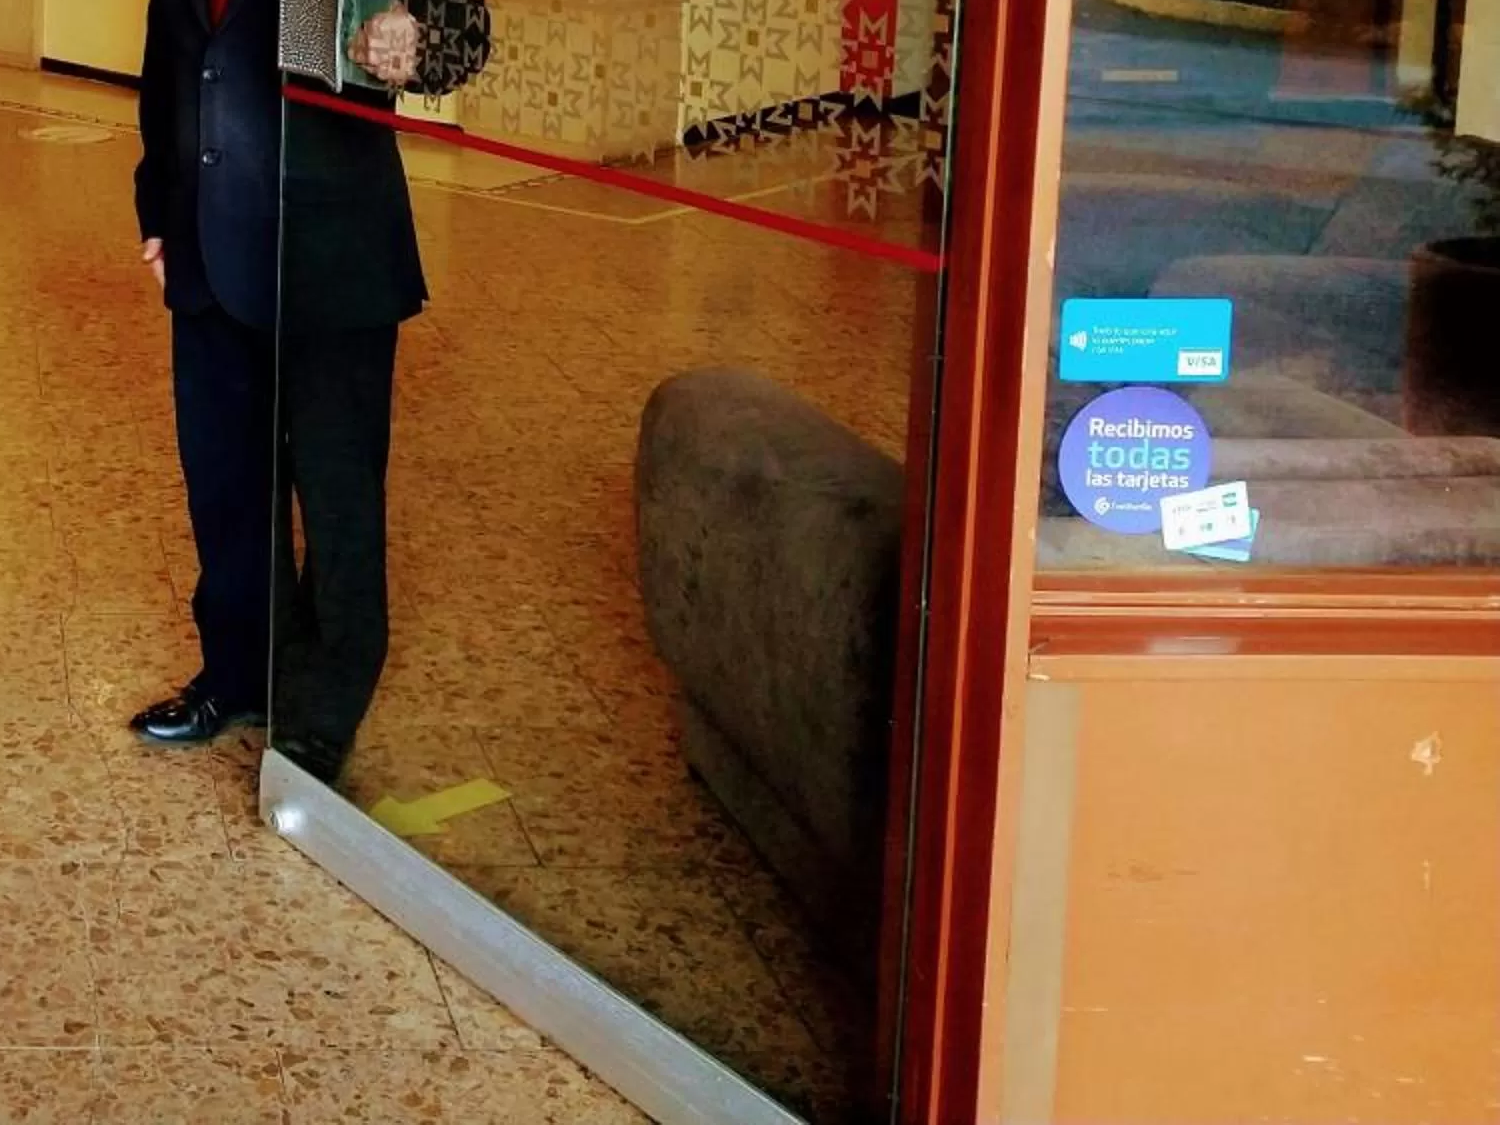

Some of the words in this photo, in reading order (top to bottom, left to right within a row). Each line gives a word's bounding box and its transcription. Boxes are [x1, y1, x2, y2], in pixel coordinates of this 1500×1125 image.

[1187, 356, 1217, 367] VISA
[1089, 418, 1194, 439] Recibimos
[1087, 440, 1192, 470] todas
[1086, 470, 1112, 487] las
[1117, 472, 1190, 493] tarjetas
